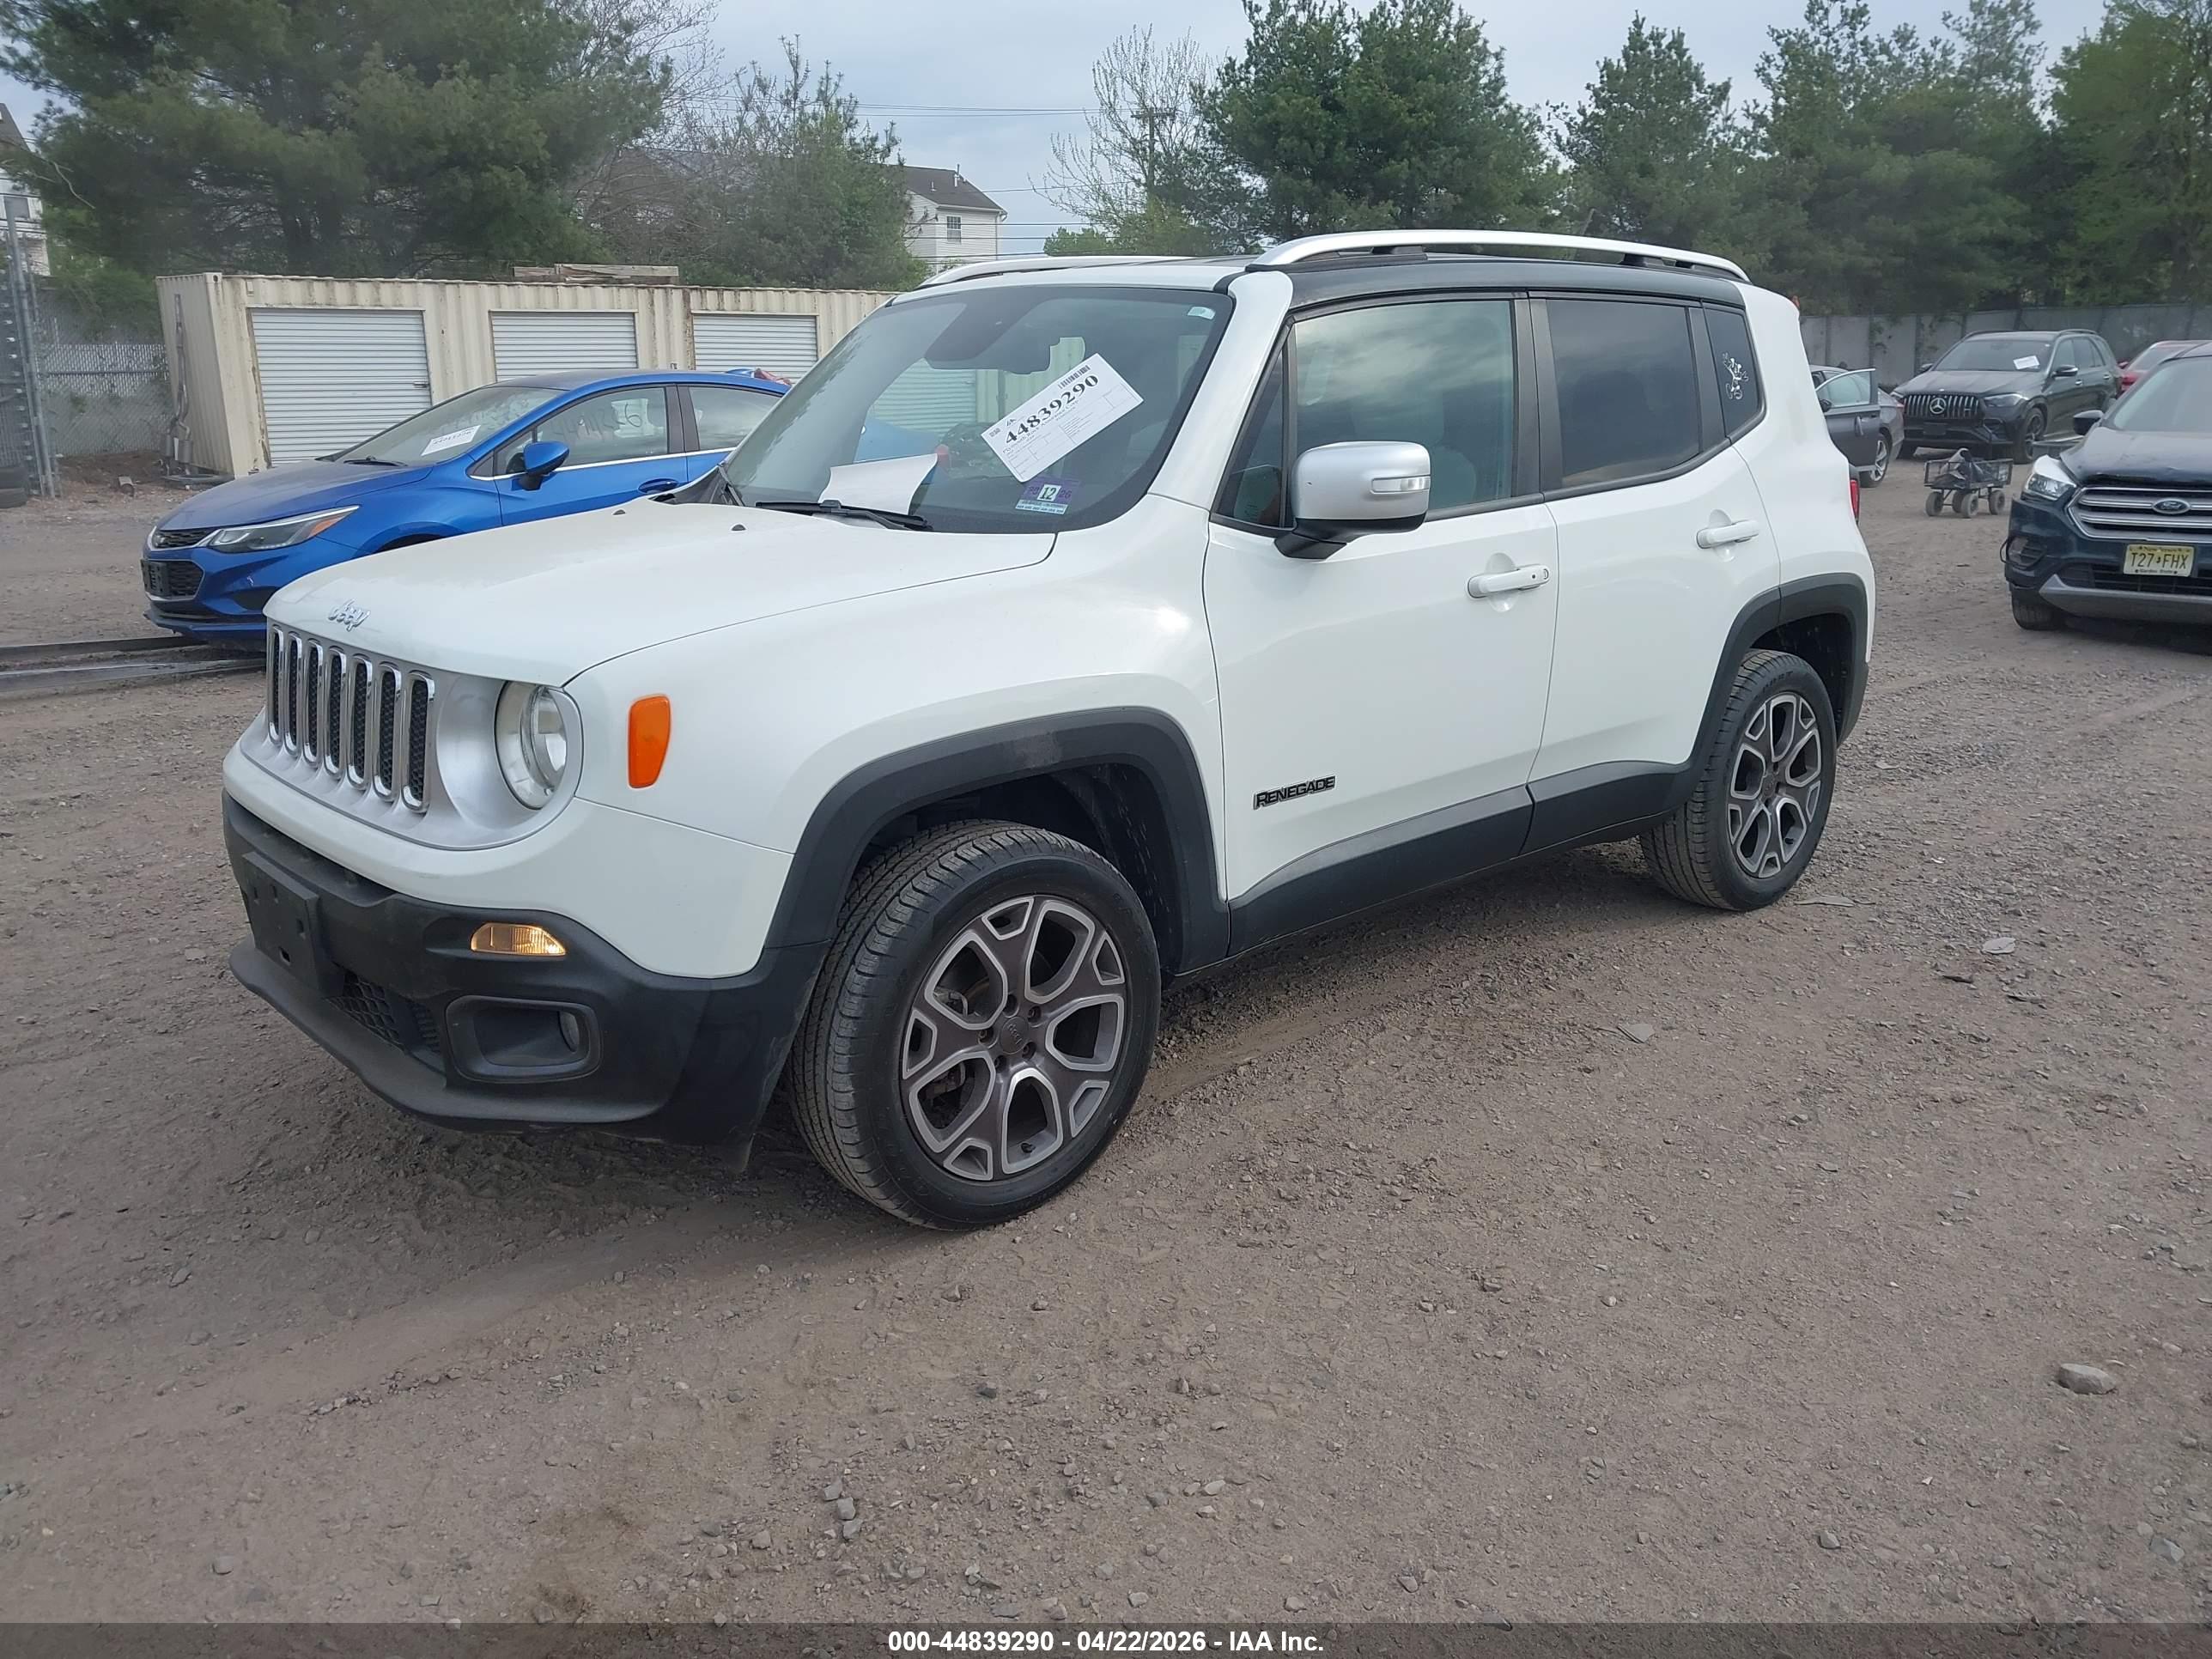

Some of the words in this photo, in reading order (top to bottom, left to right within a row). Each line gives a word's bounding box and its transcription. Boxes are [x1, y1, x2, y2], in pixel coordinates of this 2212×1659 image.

[1006, 375, 1098, 444] 44839290
[1040, 487, 1056, 500] 12
[2131, 552, 2154, 568] T27
[2161, 554, 2189, 569] FHX
[328, 599, 370, 632] Jeep
